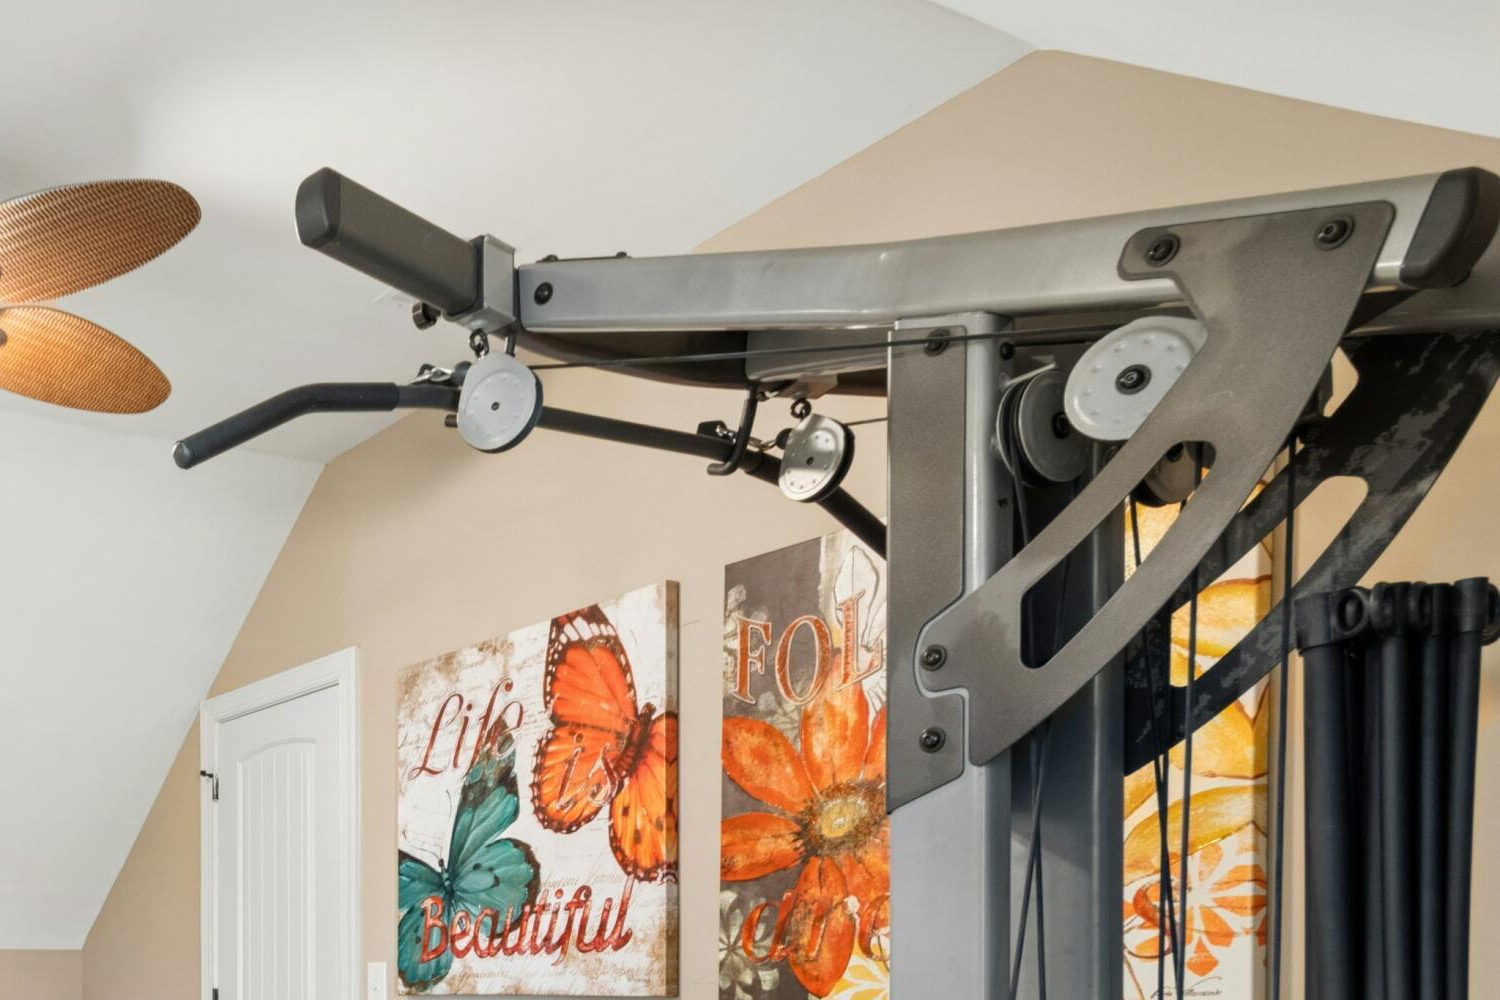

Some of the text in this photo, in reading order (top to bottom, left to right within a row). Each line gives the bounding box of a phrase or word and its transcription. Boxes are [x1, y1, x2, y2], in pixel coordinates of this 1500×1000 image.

[731, 588, 883, 705] FOL
[408, 677, 620, 809] Life is
[419, 874, 636, 966] Beautiful
